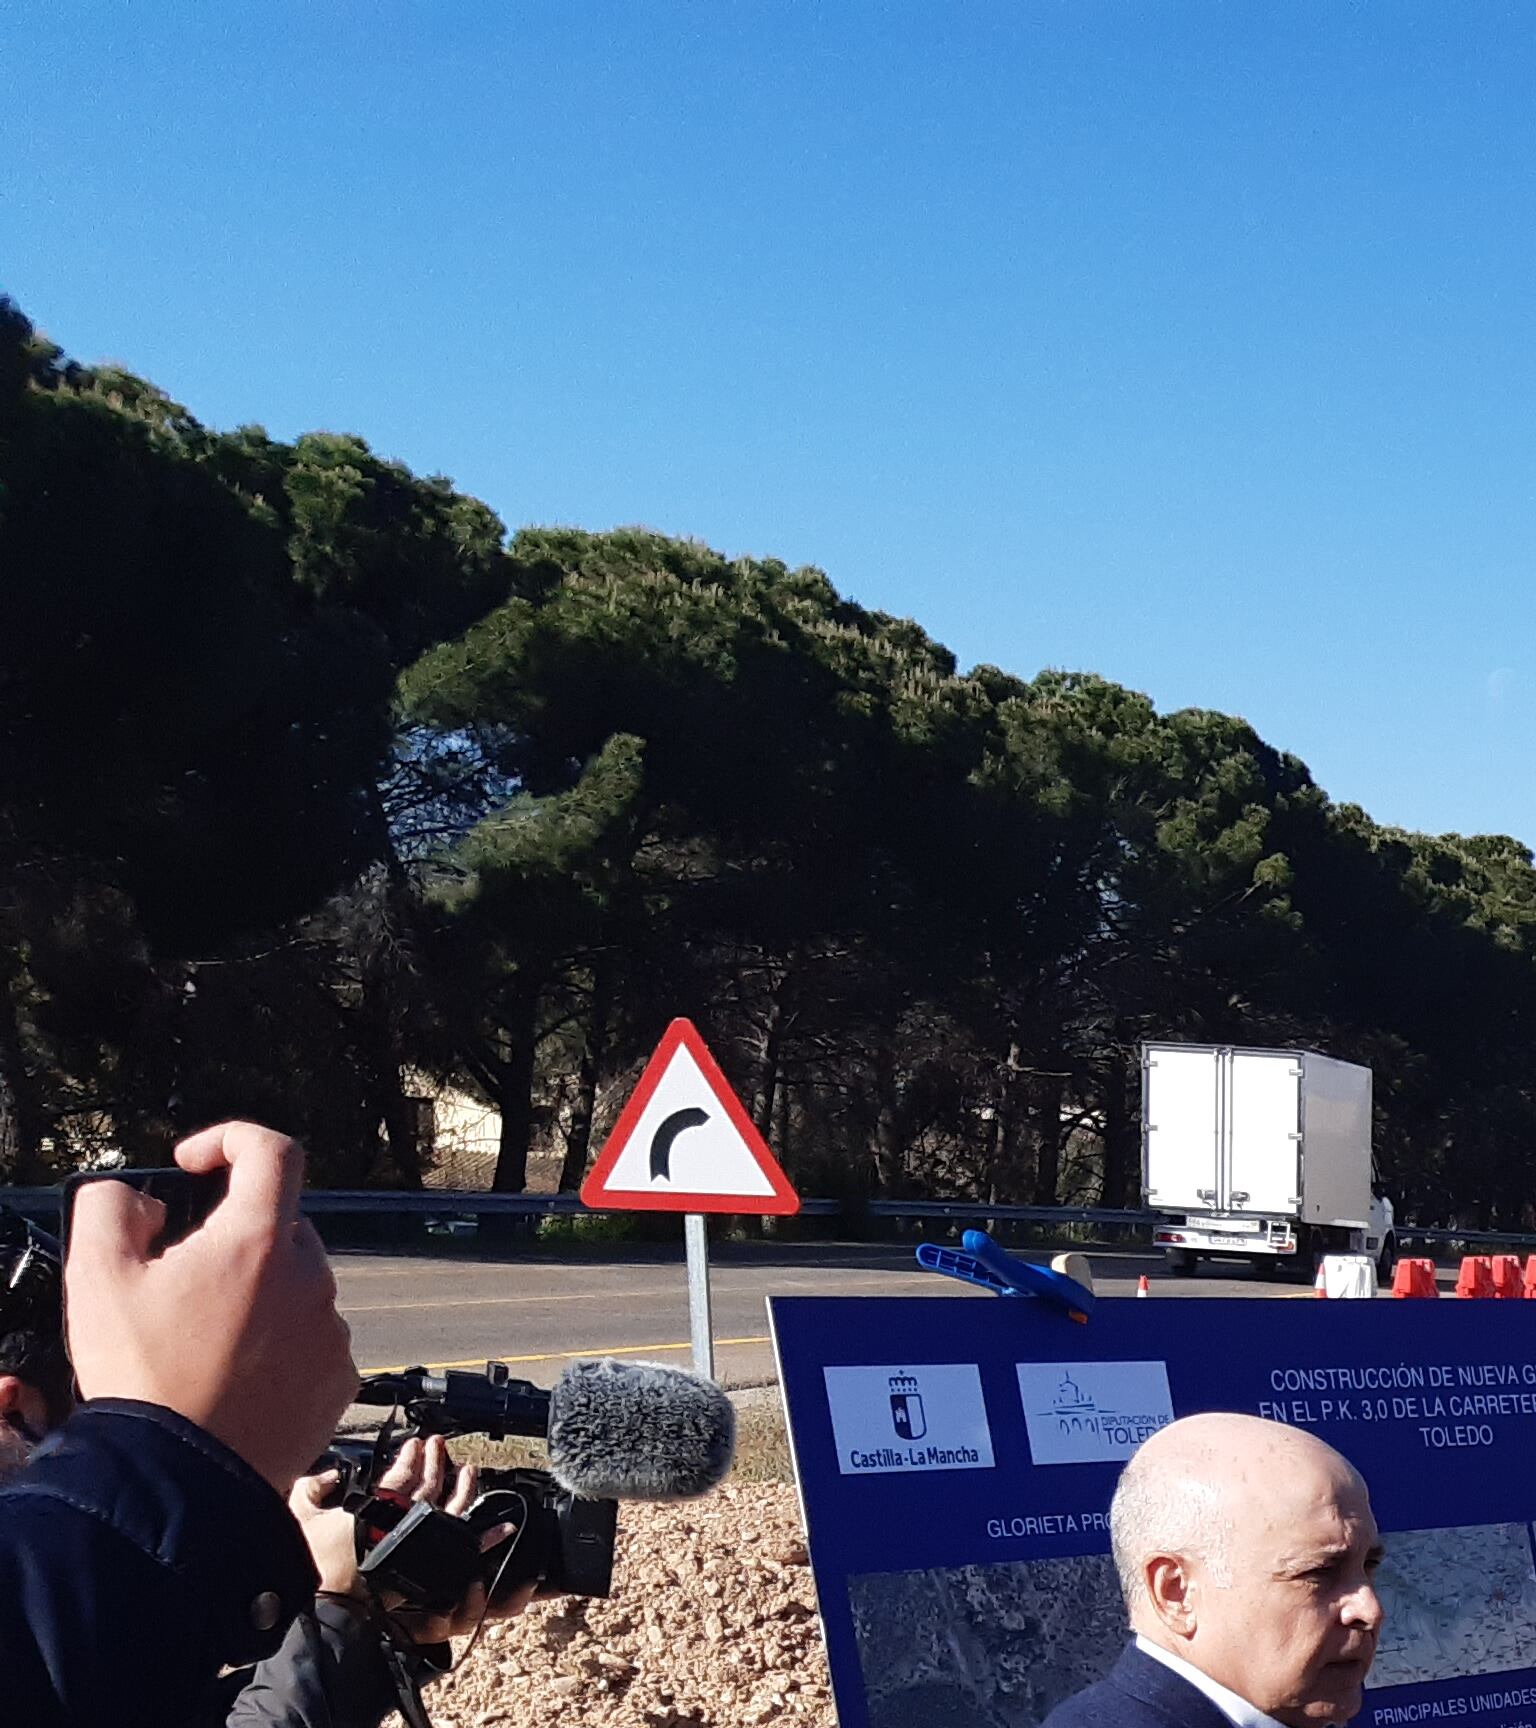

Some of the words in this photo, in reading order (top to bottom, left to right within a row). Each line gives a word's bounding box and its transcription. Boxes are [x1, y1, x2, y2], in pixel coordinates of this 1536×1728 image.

[1271, 1362, 1424, 1391] CONSTRUCCIÓN
[1429, 1366, 1455, 1387] DE
[1458, 1365, 1519, 1386] NUEVA
[1259, 1401, 1287, 1423] EN
[1292, 1401, 1318, 1422] EL
[1321, 1400, 1357, 1421] P.K.
[1361, 1399, 1388, 1422] 3,0
[1392, 1398, 1419, 1418] DE
[1422, 1397, 1446, 1417] LA
[1419, 1424, 1493, 1447] TOLEDO
[926, 1446, 979, 1465] Mancha
[987, 1515, 1078, 1538] GLORIETA
[1374, 1698, 1467, 1725] PRINCIPALES
